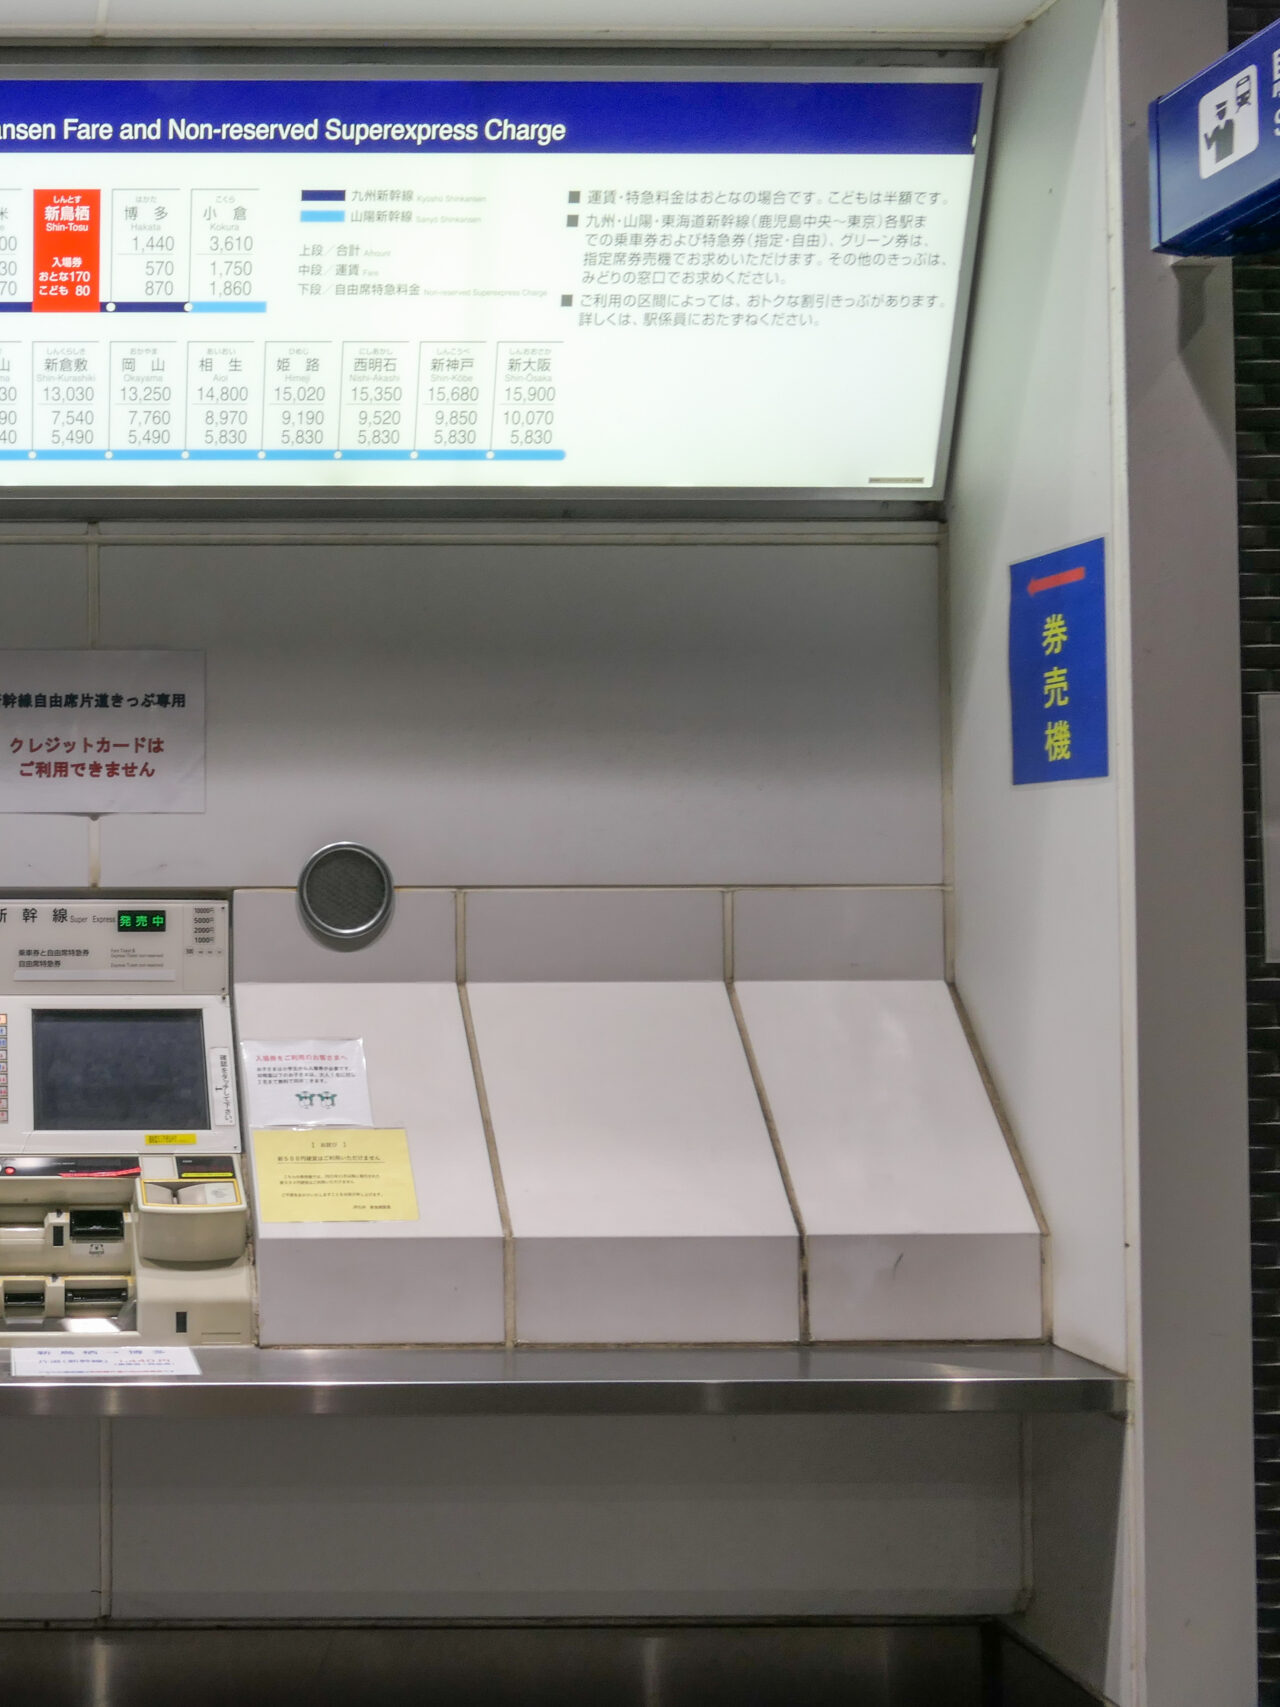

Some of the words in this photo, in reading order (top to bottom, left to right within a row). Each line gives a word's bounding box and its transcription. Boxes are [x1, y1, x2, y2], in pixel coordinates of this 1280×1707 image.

[64, 118, 113, 140] Fare
[120, 119, 161, 140] and
[169, 118, 318, 140] Non-reserved
[325, 118, 478, 145] Superexpress
[485, 118, 566, 146] Charge
[52, 195, 83, 204] しんとす
[351, 190, 414, 202] 九州新幹線
[43, 205, 91, 222] 新鳥栖
[124, 205, 169, 221] 博多
[202, 205, 248, 222] 小倉
[350, 210, 413, 223] 山陽新幹線
[45, 222, 89, 232] Shin-Tosu
[132, 235, 175, 253] 1,440
[209, 235, 254, 252] 3,610
[51, 256, 83, 268] 入場券
[145, 260, 175, 277] 570
[210, 260, 253, 277] 1,750
[38, 285, 69, 296] こども
[74, 285, 91, 297] 80
[44, 357, 88, 373] 新倉敷
[121, 357, 166, 373] 岡山
[198, 357, 243, 372] 相生
[276, 357, 320, 372] 姫路
[353, 357, 398, 373] 西明石
[430, 357, 475, 372] 新神戸
[507, 357, 552, 375] 新大阪
[43, 385, 95, 402] 13,030
[120, 386, 172, 402] 13,250
[197, 385, 249, 405] 14,800
[274, 385, 326, 402] 15,020
[351, 385, 403, 403] 15,350
[428, 385, 480, 402] 15,680
[504, 386, 556, 402] 15,900
[51, 409, 95, 426] 7,540
[204, 409, 248, 426] 8,970
[358, 409, 402, 427] 9,520
[503, 410, 555, 426] 10,070
[1041, 613, 1072, 762] 券売機
[10, 737, 164, 753] クレジットカードは
[19, 761, 156, 778] ご利用できません
[70, 915, 88, 925] Super
[92, 915, 116, 925] Express
[120, 915, 164, 927] 発売中
